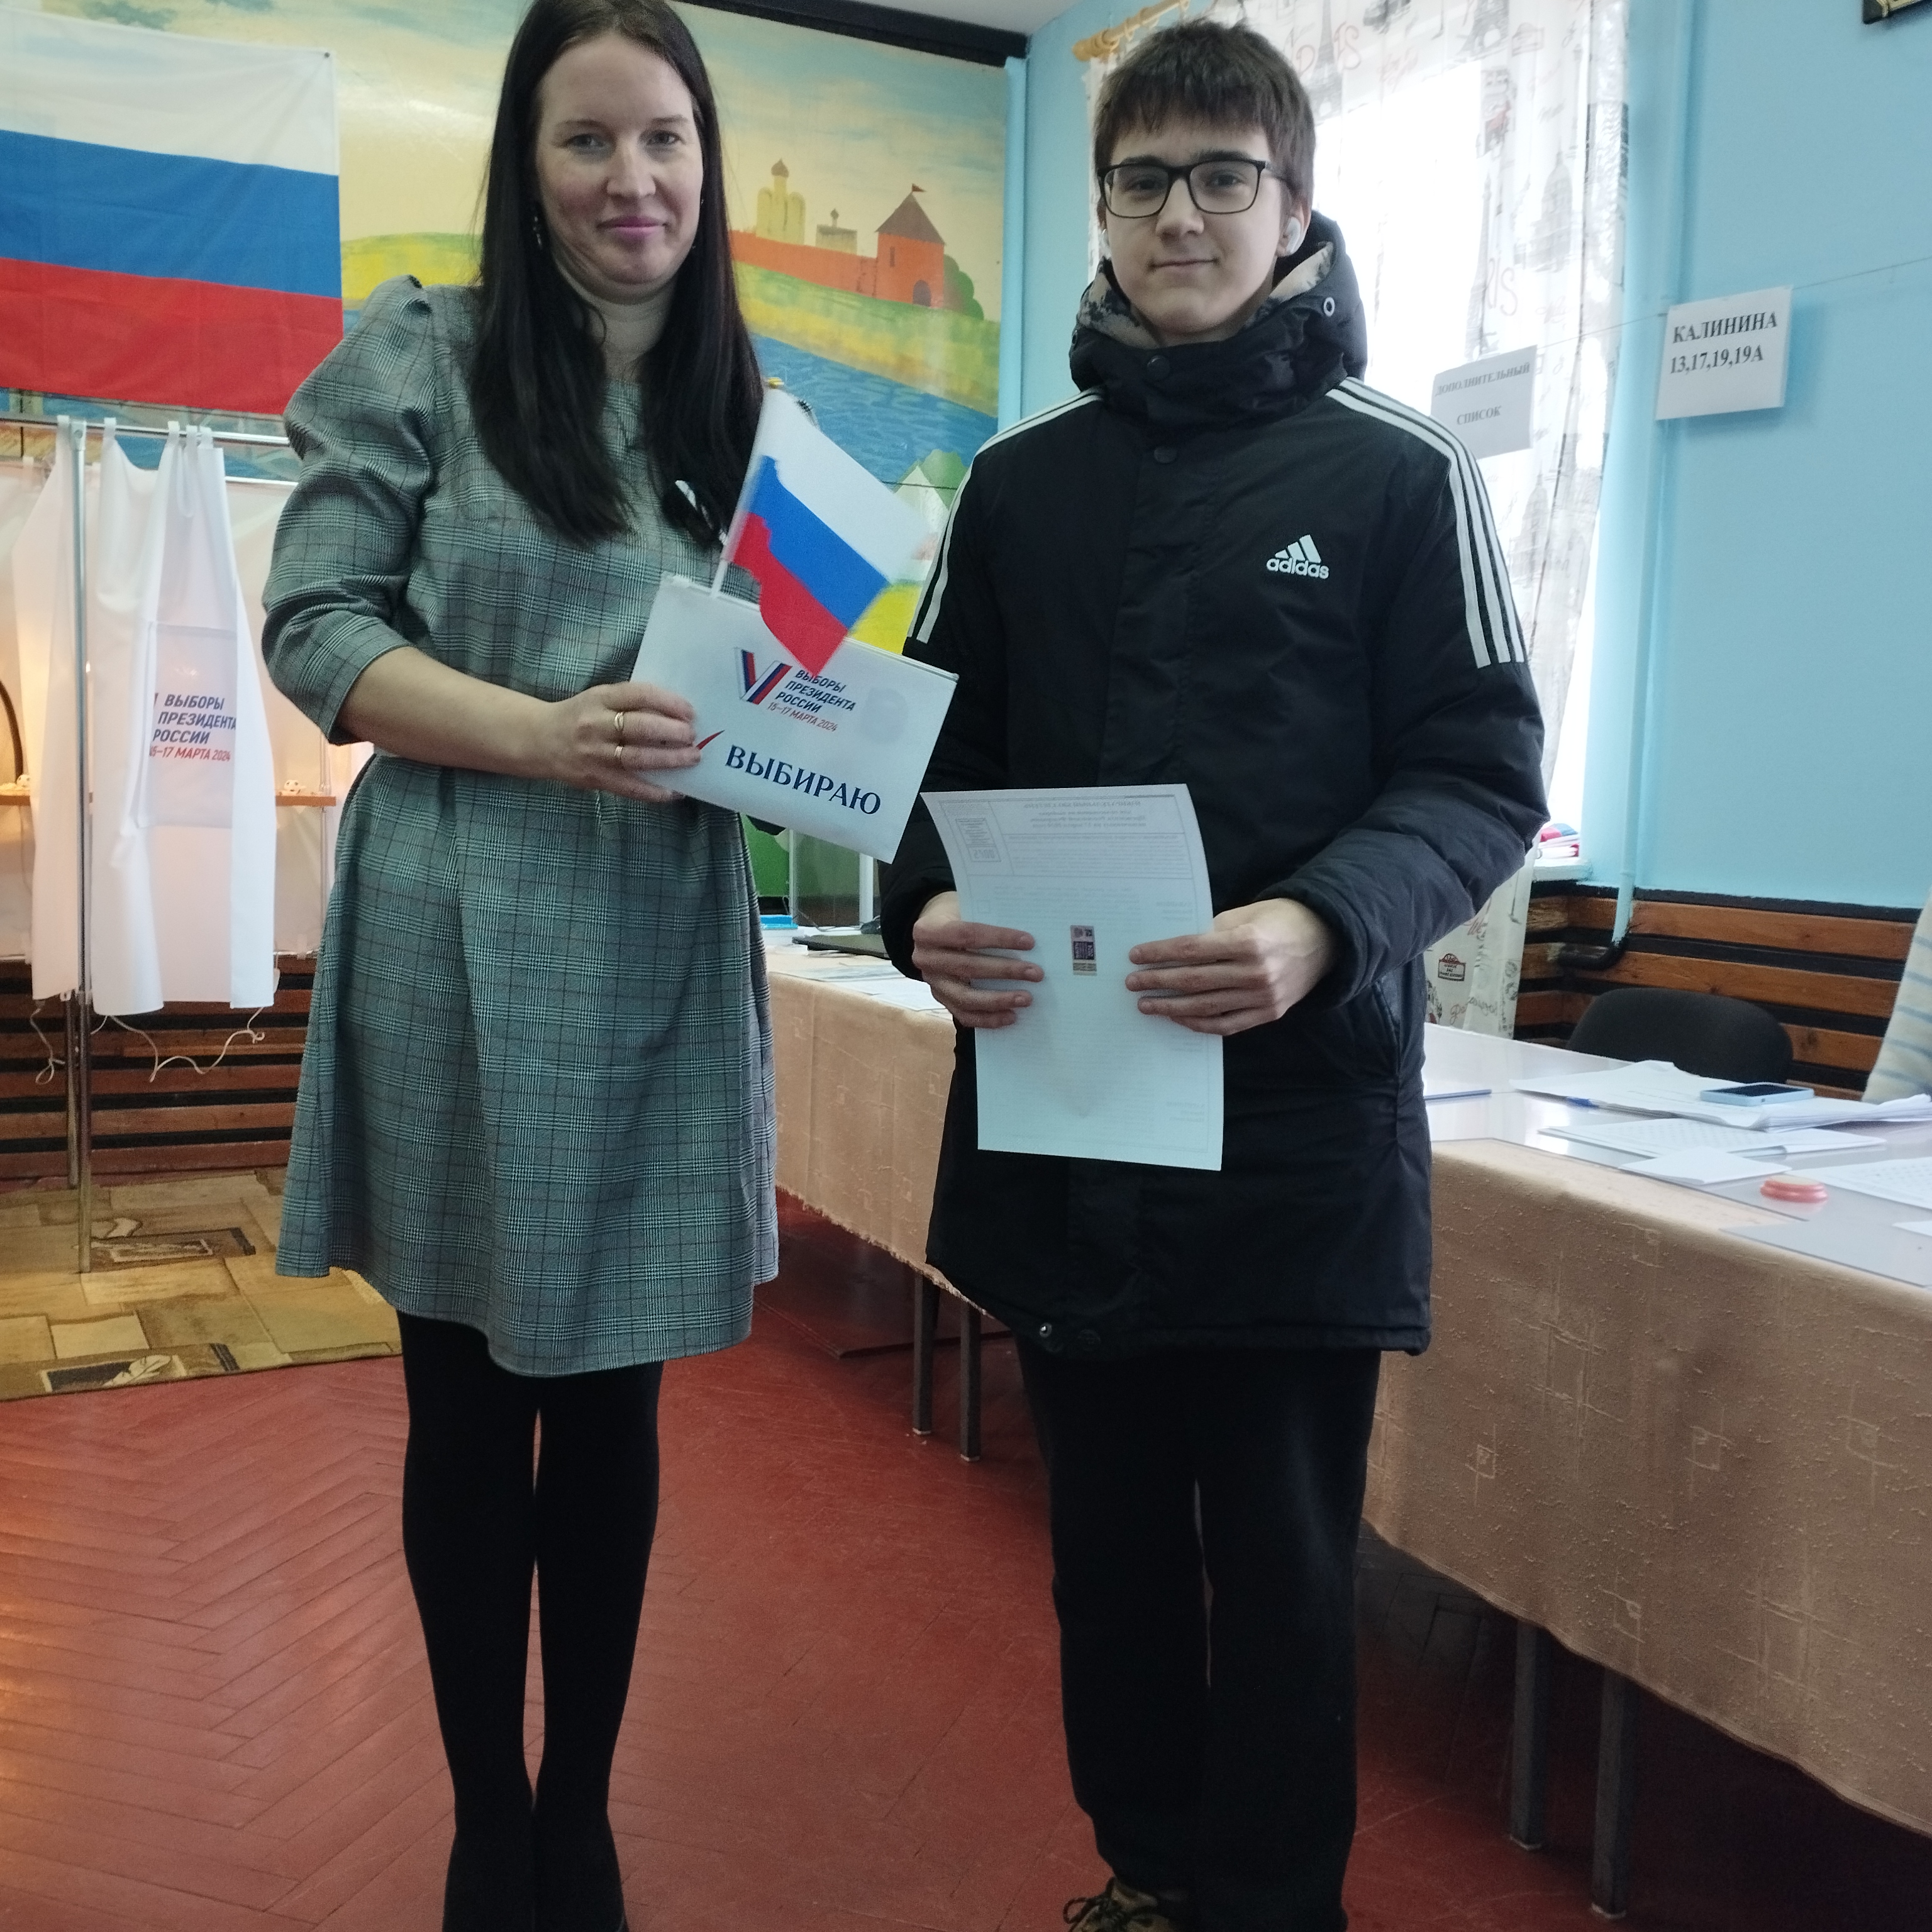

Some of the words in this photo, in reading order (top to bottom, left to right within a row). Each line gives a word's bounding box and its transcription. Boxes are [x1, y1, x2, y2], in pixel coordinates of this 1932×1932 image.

[1672, 311, 1777, 343] КАЛИНИНА
[1435, 362, 1530, 397] ДОПОЛНИТЕЛЬНЫЙ
[1457, 406, 1501, 426] СПИСОК
[1266, 557, 1330, 579] adidas
[795, 669, 847, 693] ВЫБОРЫ
[164, 694, 225, 710] ВЫБОРЫ
[775, 691, 823, 713] РОССИИ
[785, 680, 857, 711] ПРЕЗИДЕНТА
[157, 711, 236, 730] ПРЕЗИДЕНТА
[789, 709, 818, 725] МАРТА
[817, 719, 838, 732] 2024
[152, 729, 211, 745] РОССИИ
[174, 747, 211, 760] МАРТА
[211, 749, 231, 762] 2024
[724, 745, 882, 815] ВЫБИРАЮ
